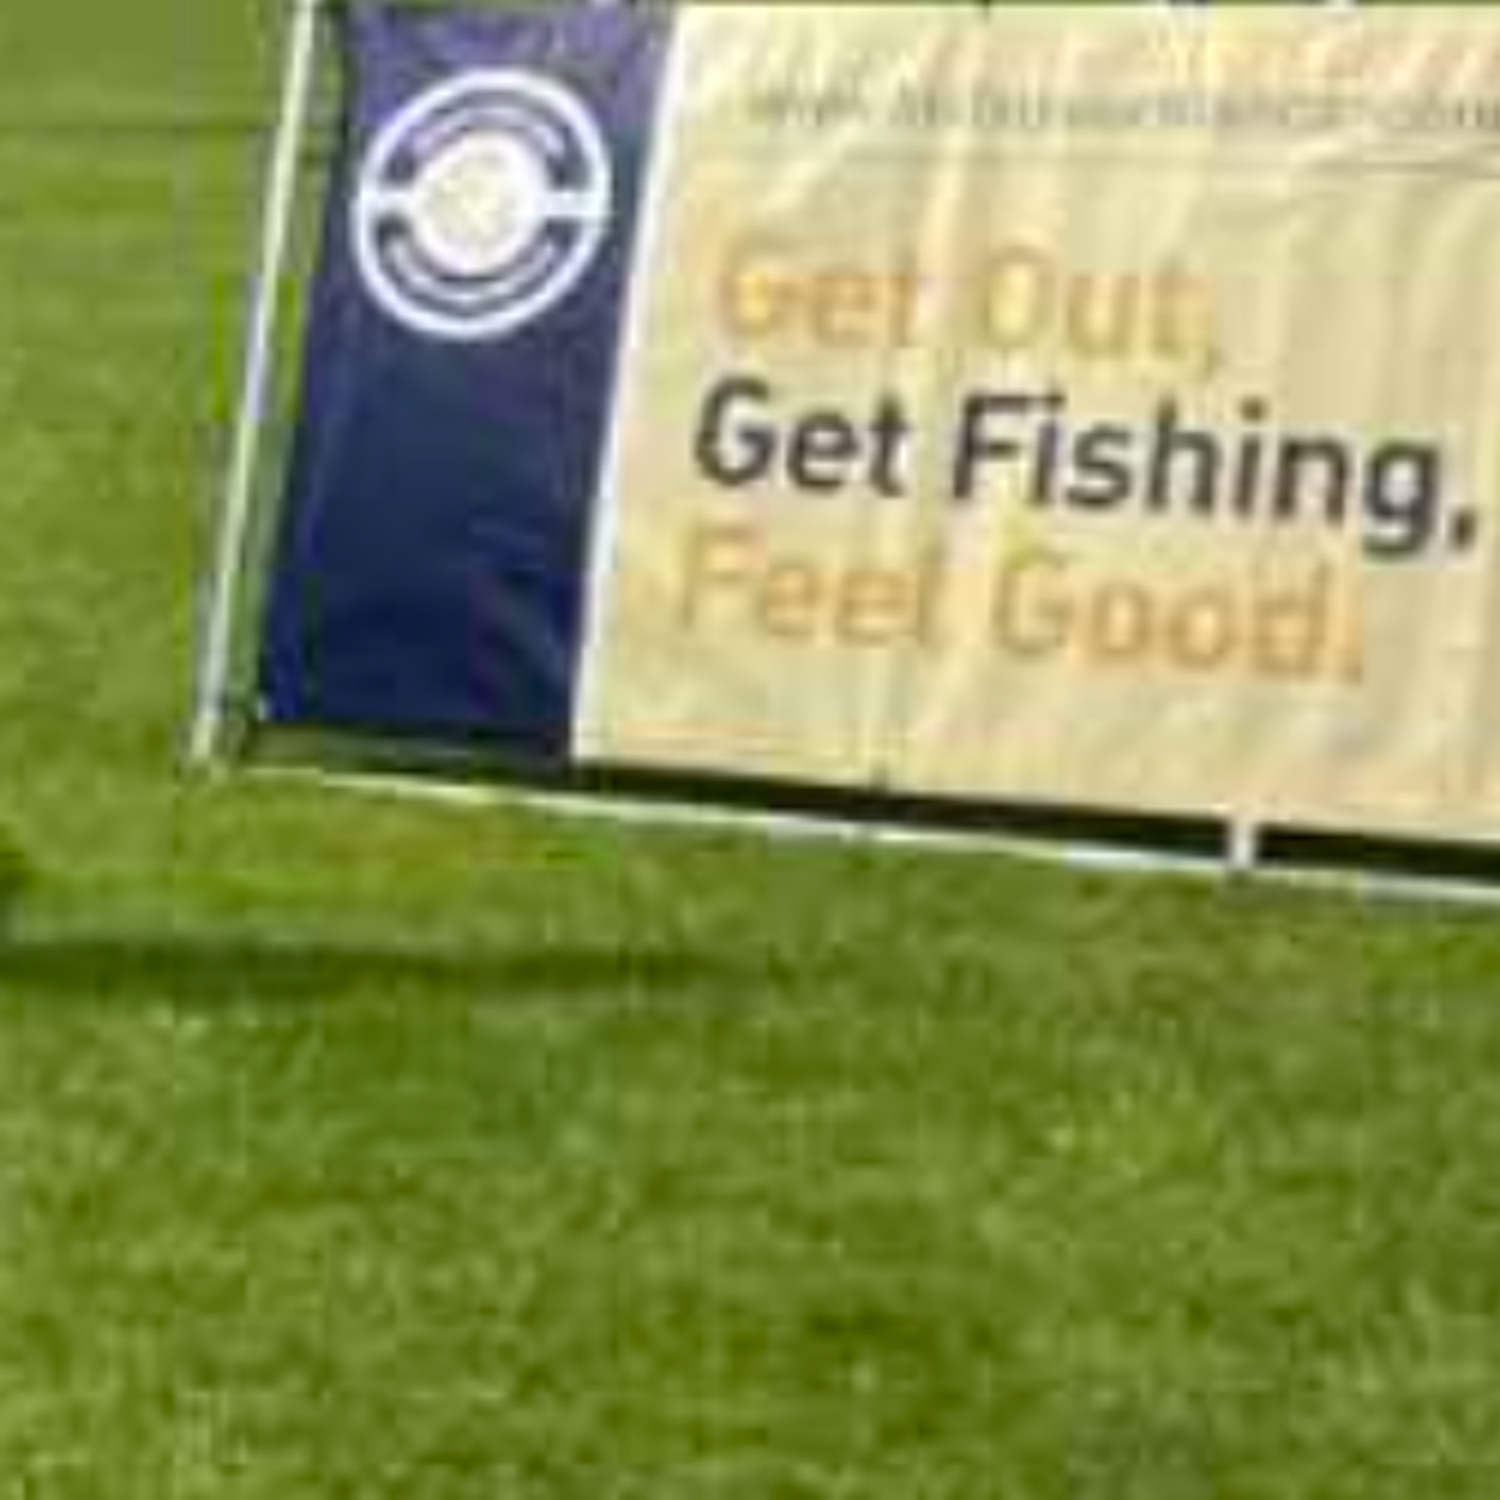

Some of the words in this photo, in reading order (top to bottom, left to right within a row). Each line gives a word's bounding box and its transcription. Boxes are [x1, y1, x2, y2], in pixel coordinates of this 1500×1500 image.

[717, 244, 918, 348] Get
[982, 246, 1219, 376] Out,
[694, 376, 912, 496] Get
[684, 520, 938, 648] Feel
[996, 546, 1364, 686] Good.
